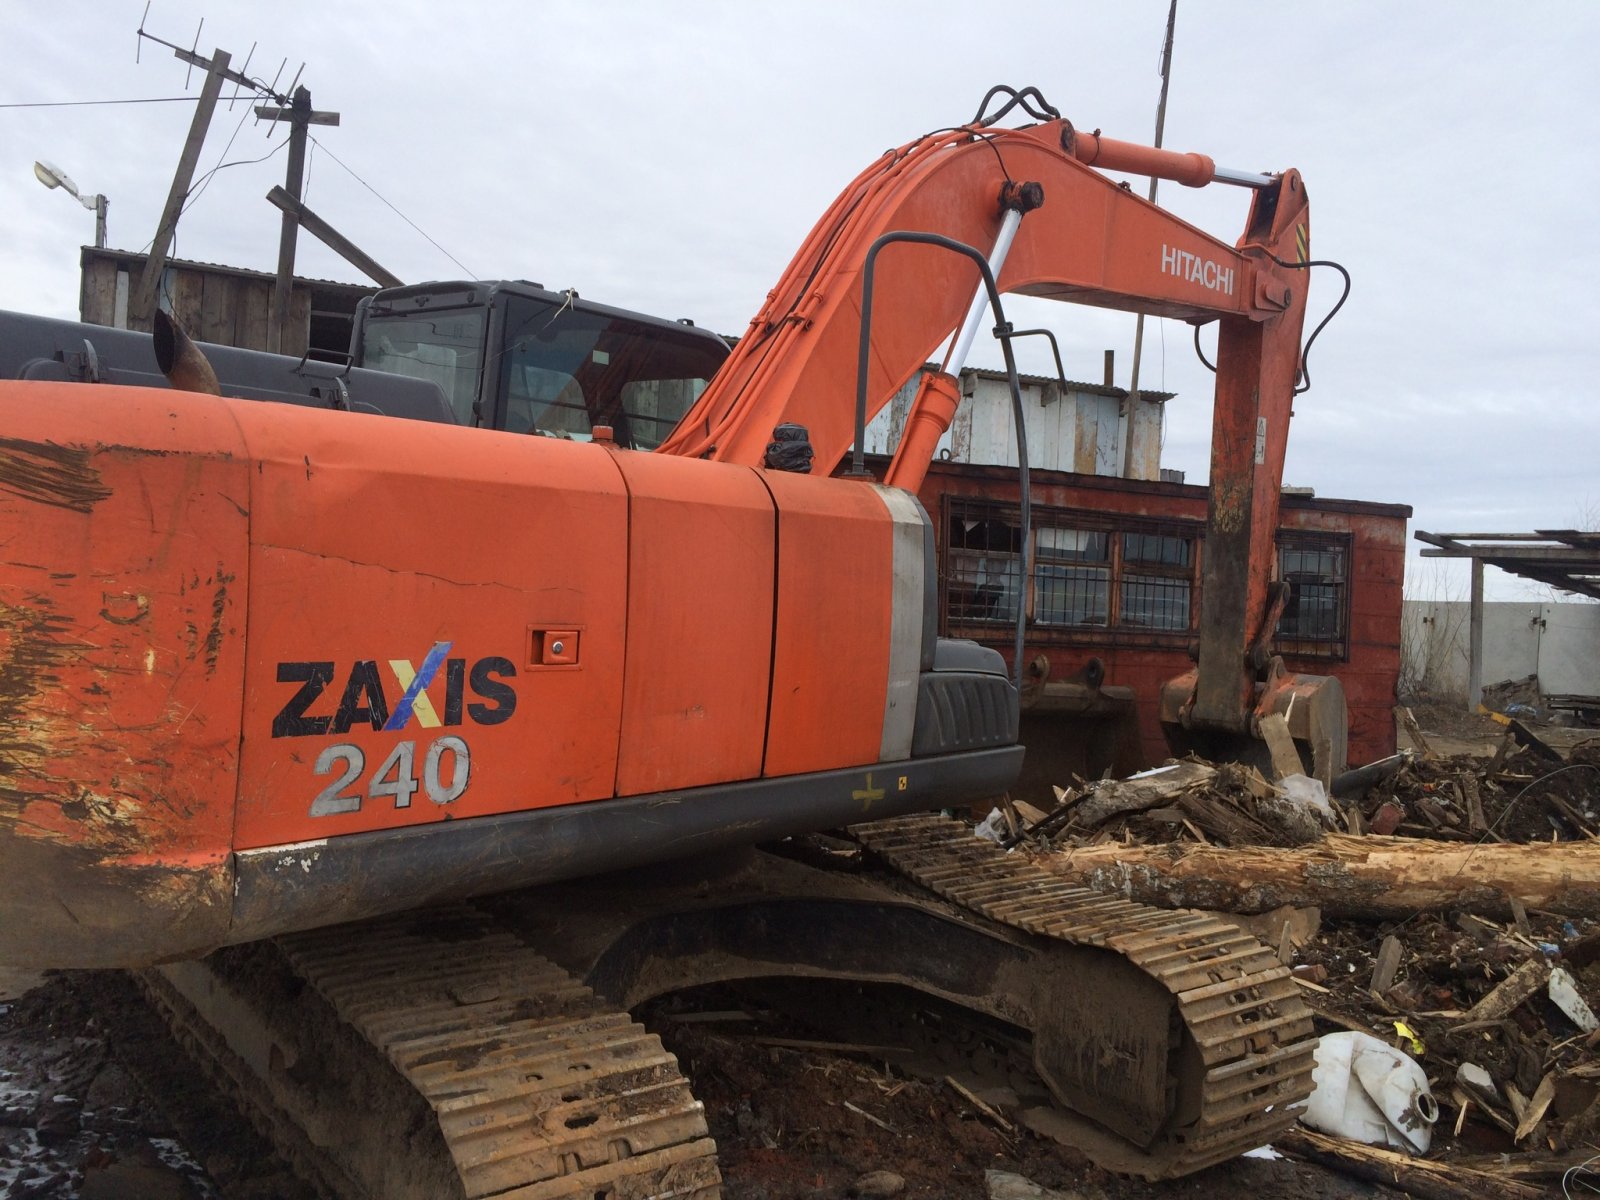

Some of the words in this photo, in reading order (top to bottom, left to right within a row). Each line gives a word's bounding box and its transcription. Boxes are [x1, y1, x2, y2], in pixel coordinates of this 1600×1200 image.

[1161, 243, 1234, 296] HITACHI
[272, 641, 517, 738] ZAXIS
[308, 735, 471, 817] 240
